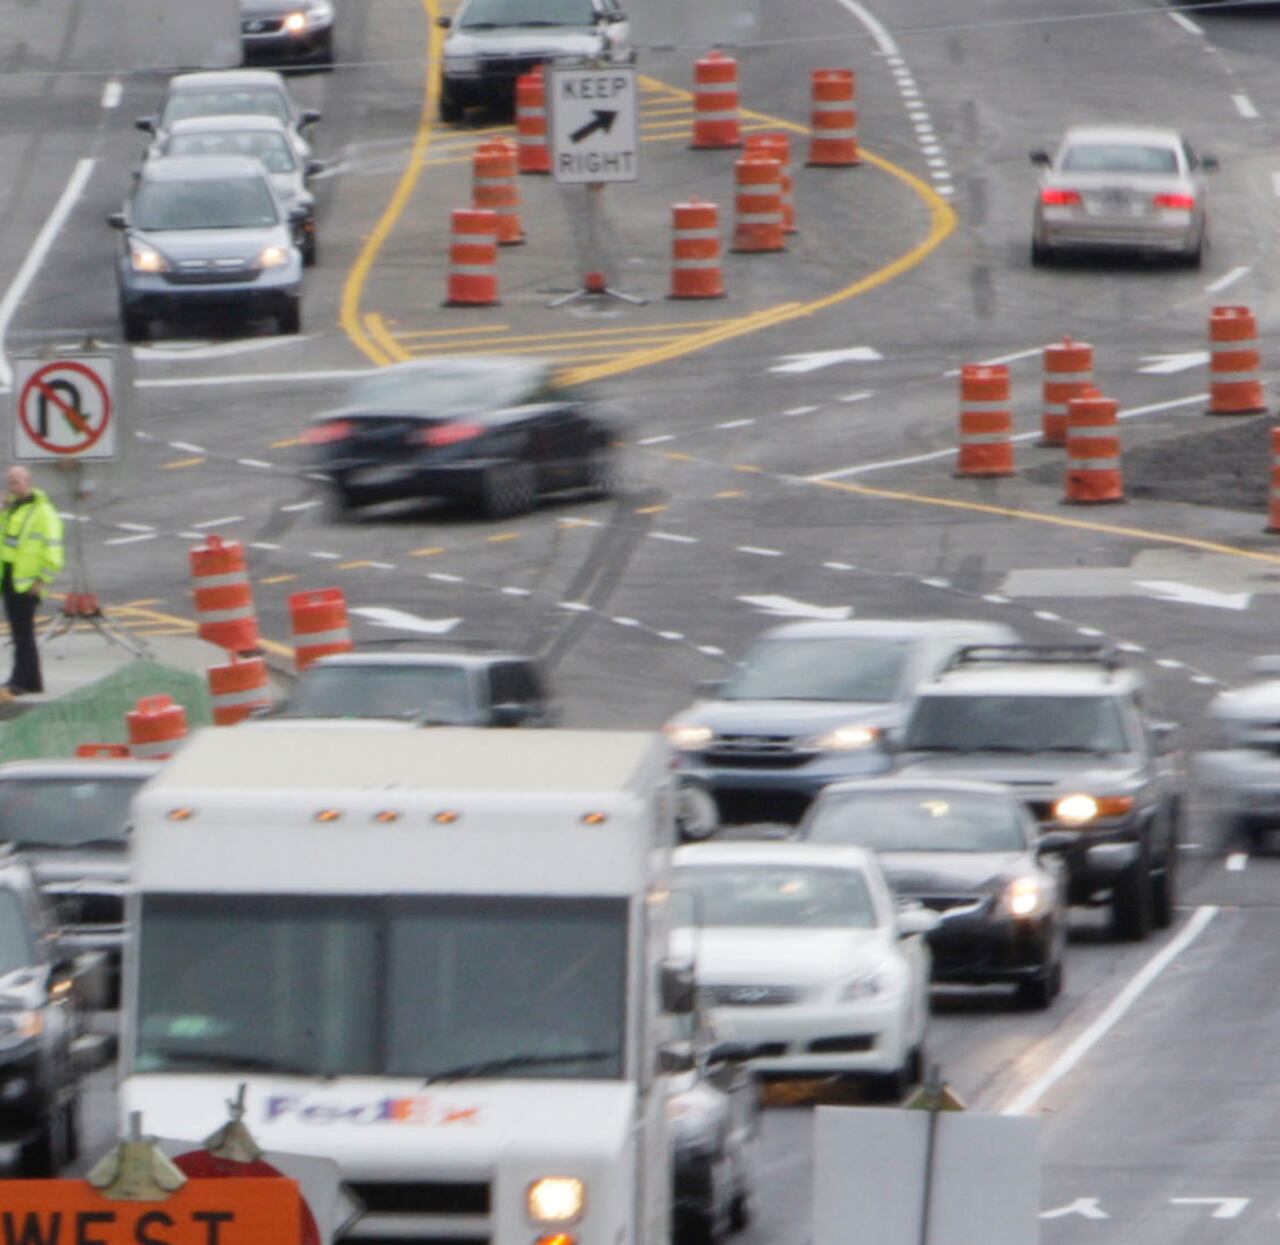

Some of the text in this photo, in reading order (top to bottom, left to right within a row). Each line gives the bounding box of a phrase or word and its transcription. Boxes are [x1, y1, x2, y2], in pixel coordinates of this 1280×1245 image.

[561, 78, 626, 99] KEEP
[559, 152, 633, 173] RIGHT
[264, 1095, 482, 1125] FedEx
